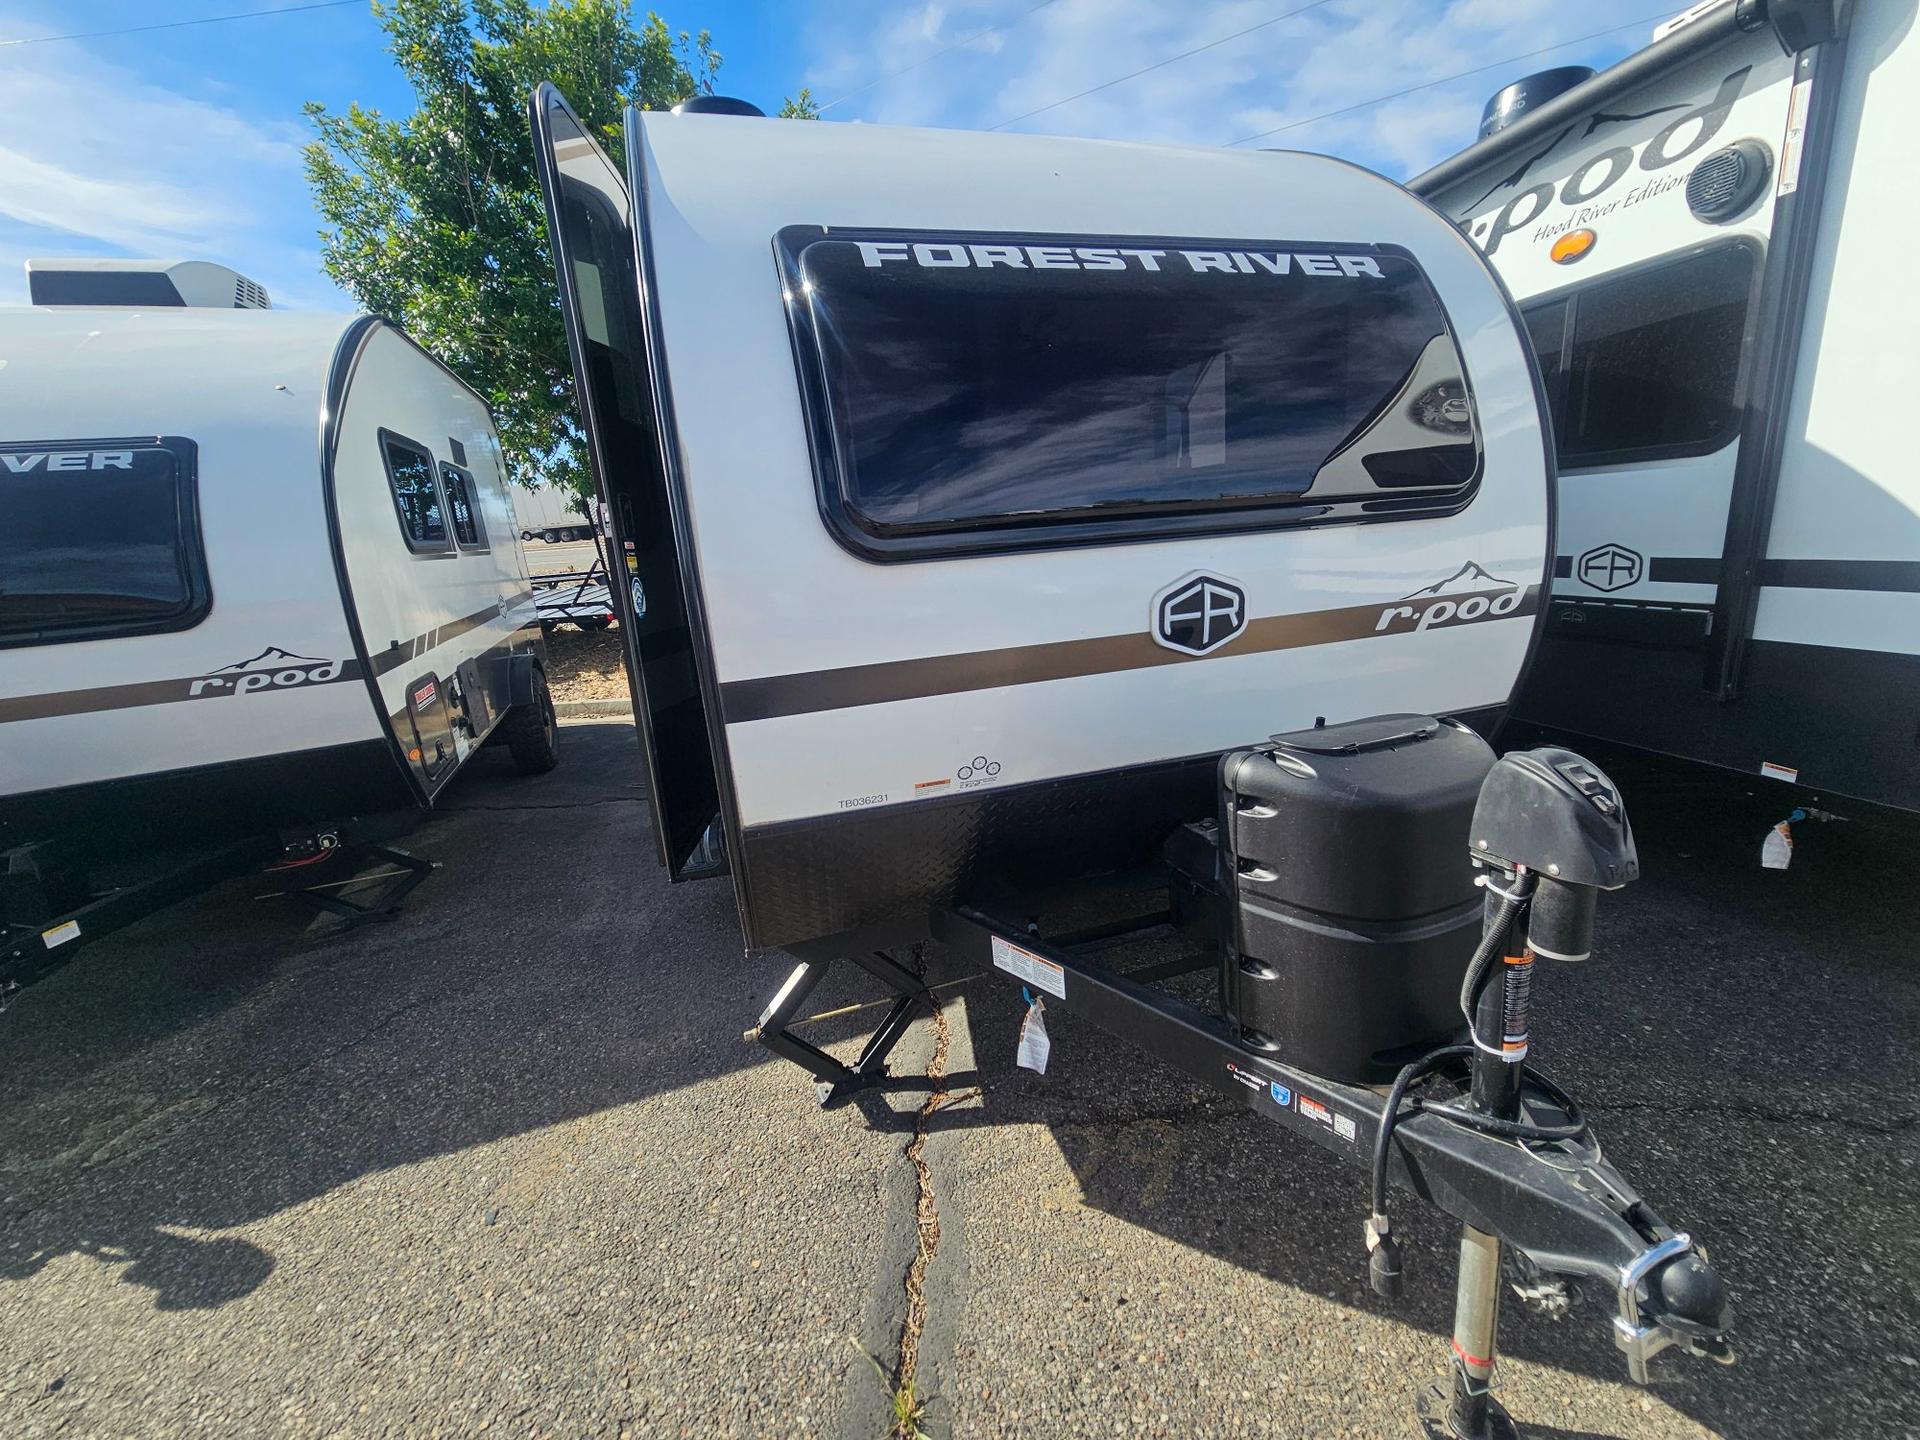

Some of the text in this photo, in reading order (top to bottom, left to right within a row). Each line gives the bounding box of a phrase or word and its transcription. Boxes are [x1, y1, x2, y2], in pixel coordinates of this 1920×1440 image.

[1533, 172, 1692, 243] Hood River Edition
[853, 242, 1386, 278] FOREST RIVER
[838, 794, 889, 809] TB036231
